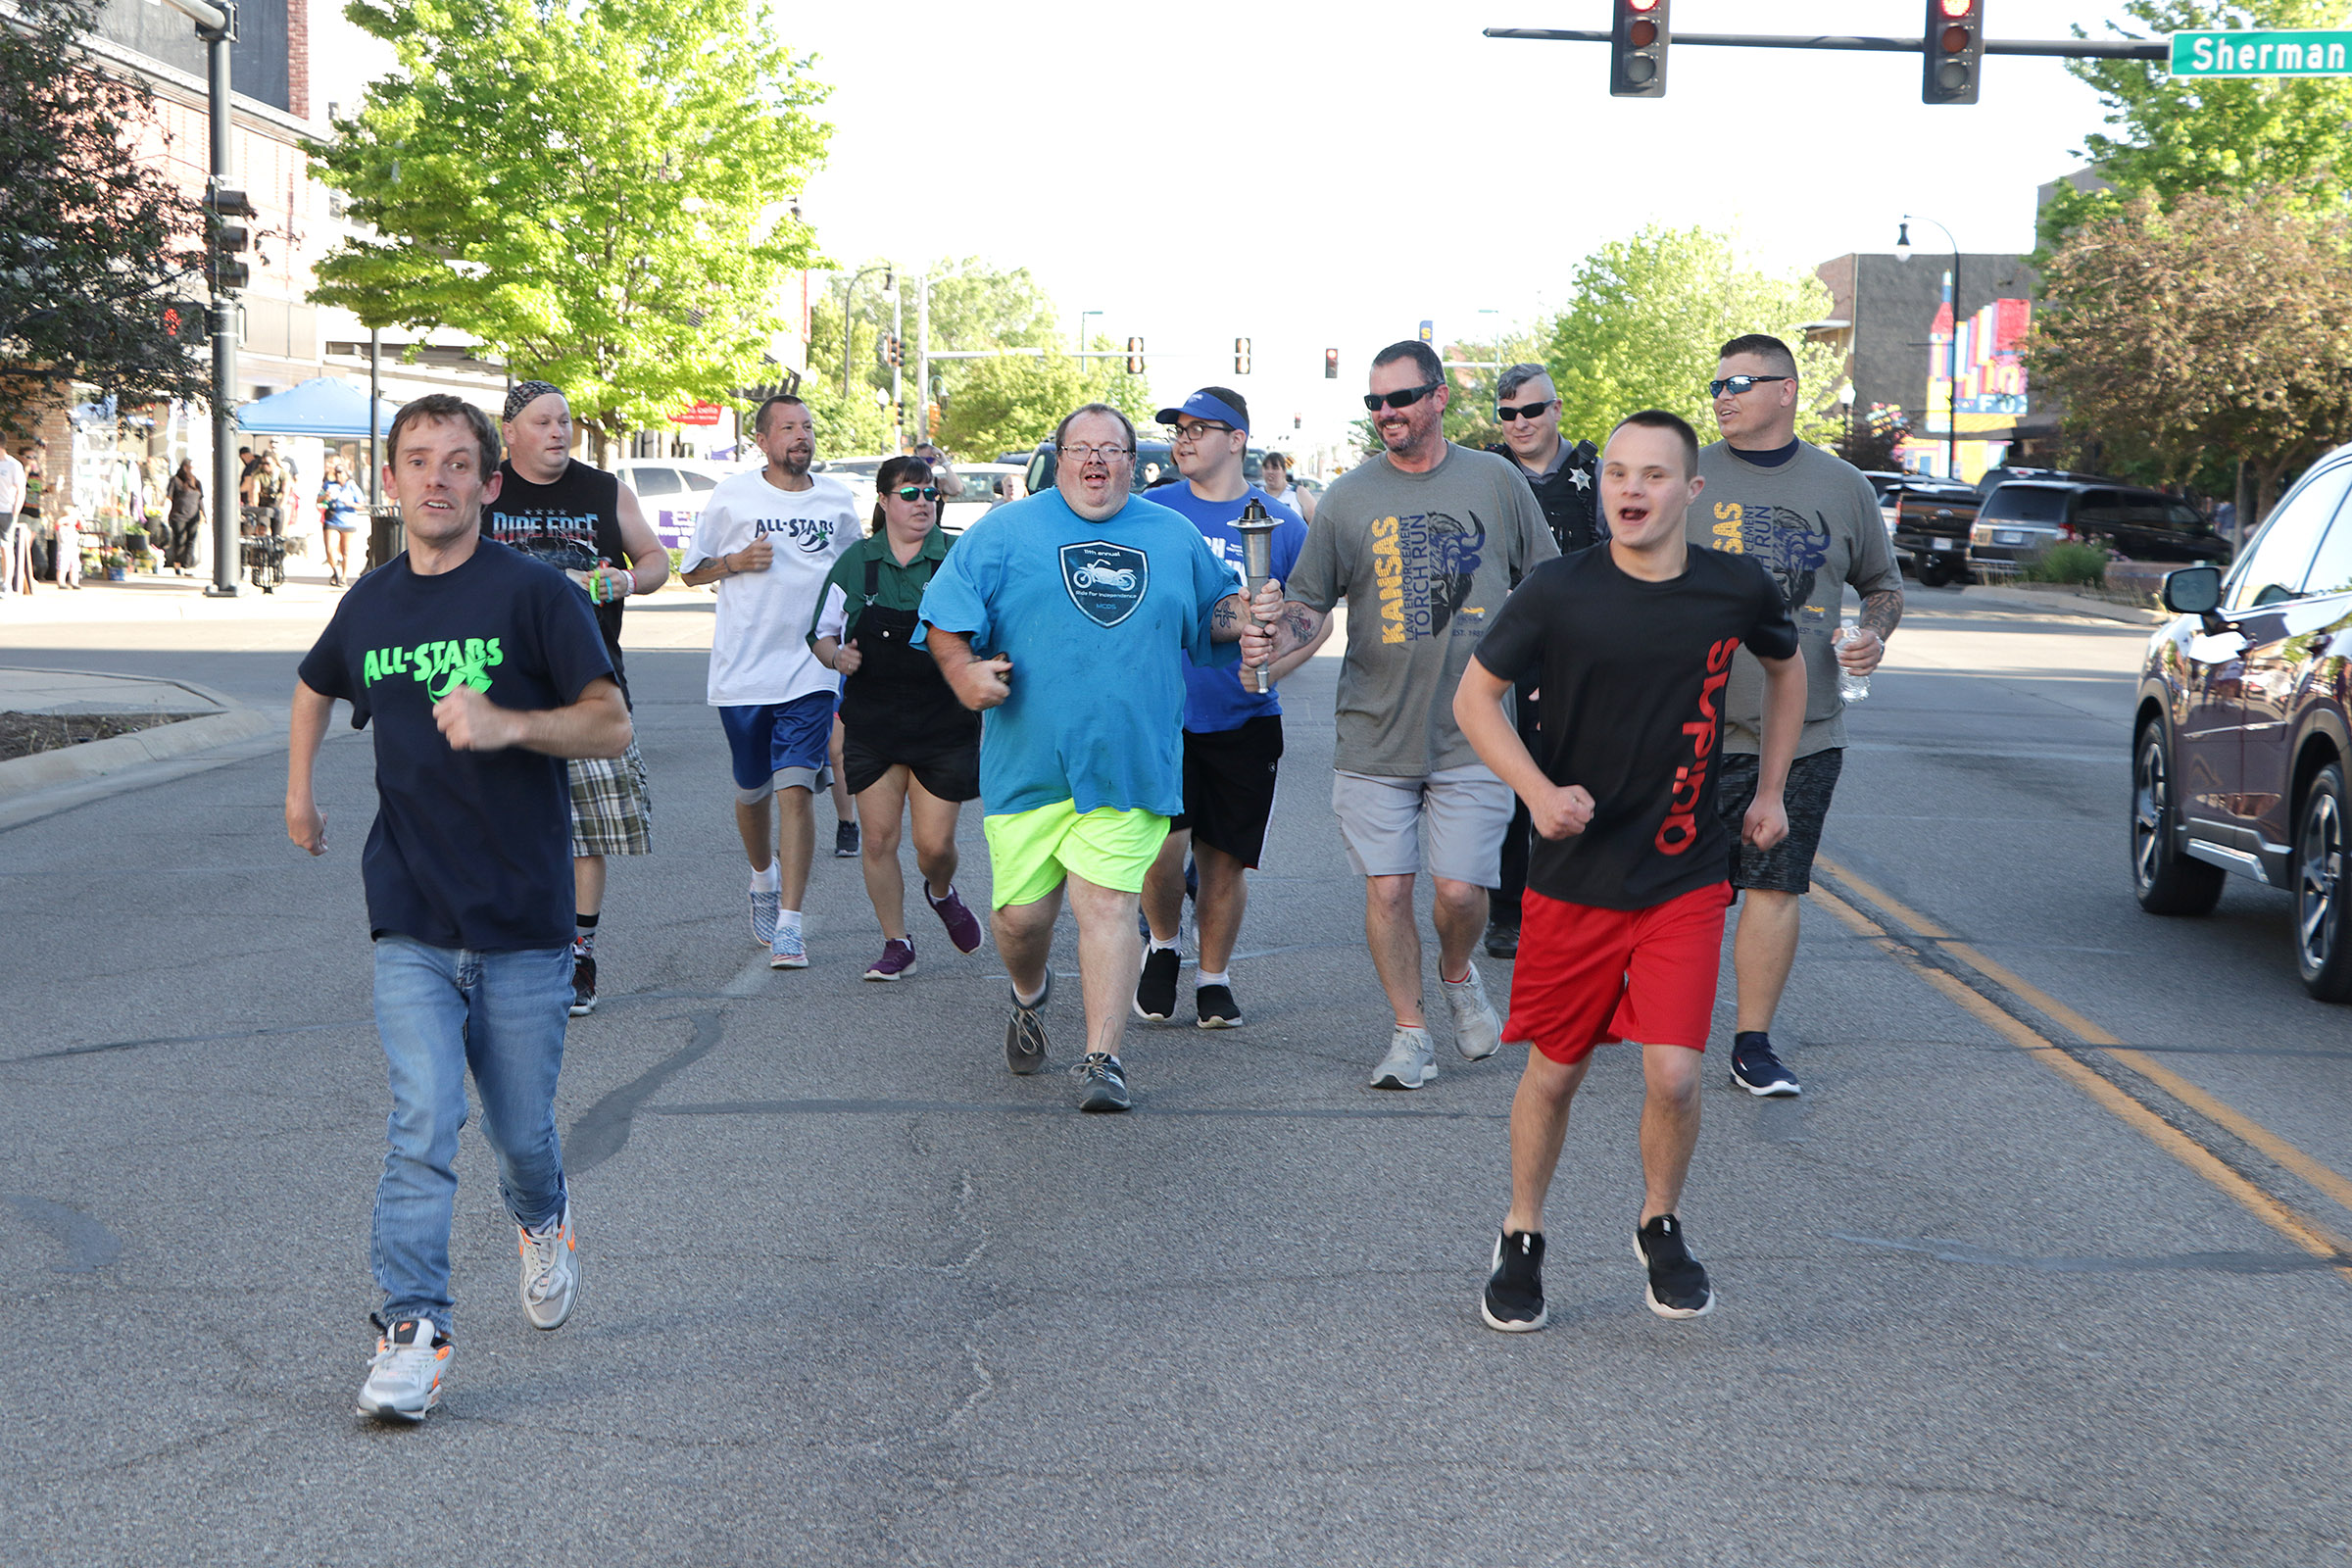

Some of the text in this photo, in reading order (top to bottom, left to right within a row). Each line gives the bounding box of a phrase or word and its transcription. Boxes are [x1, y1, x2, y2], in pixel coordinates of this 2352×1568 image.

[2191, 36, 2346, 71] Sherman
[754, 518, 835, 539] ALL-STARS
[1754, 506, 1772, 549] RUN
[1372, 515, 1405, 644] KANSAS
[1399, 514, 1416, 641] LAW ENFORCEMENT
[1409, 514, 1431, 641] TORCH RUN
[364, 637, 505, 689] ALL-STARS
